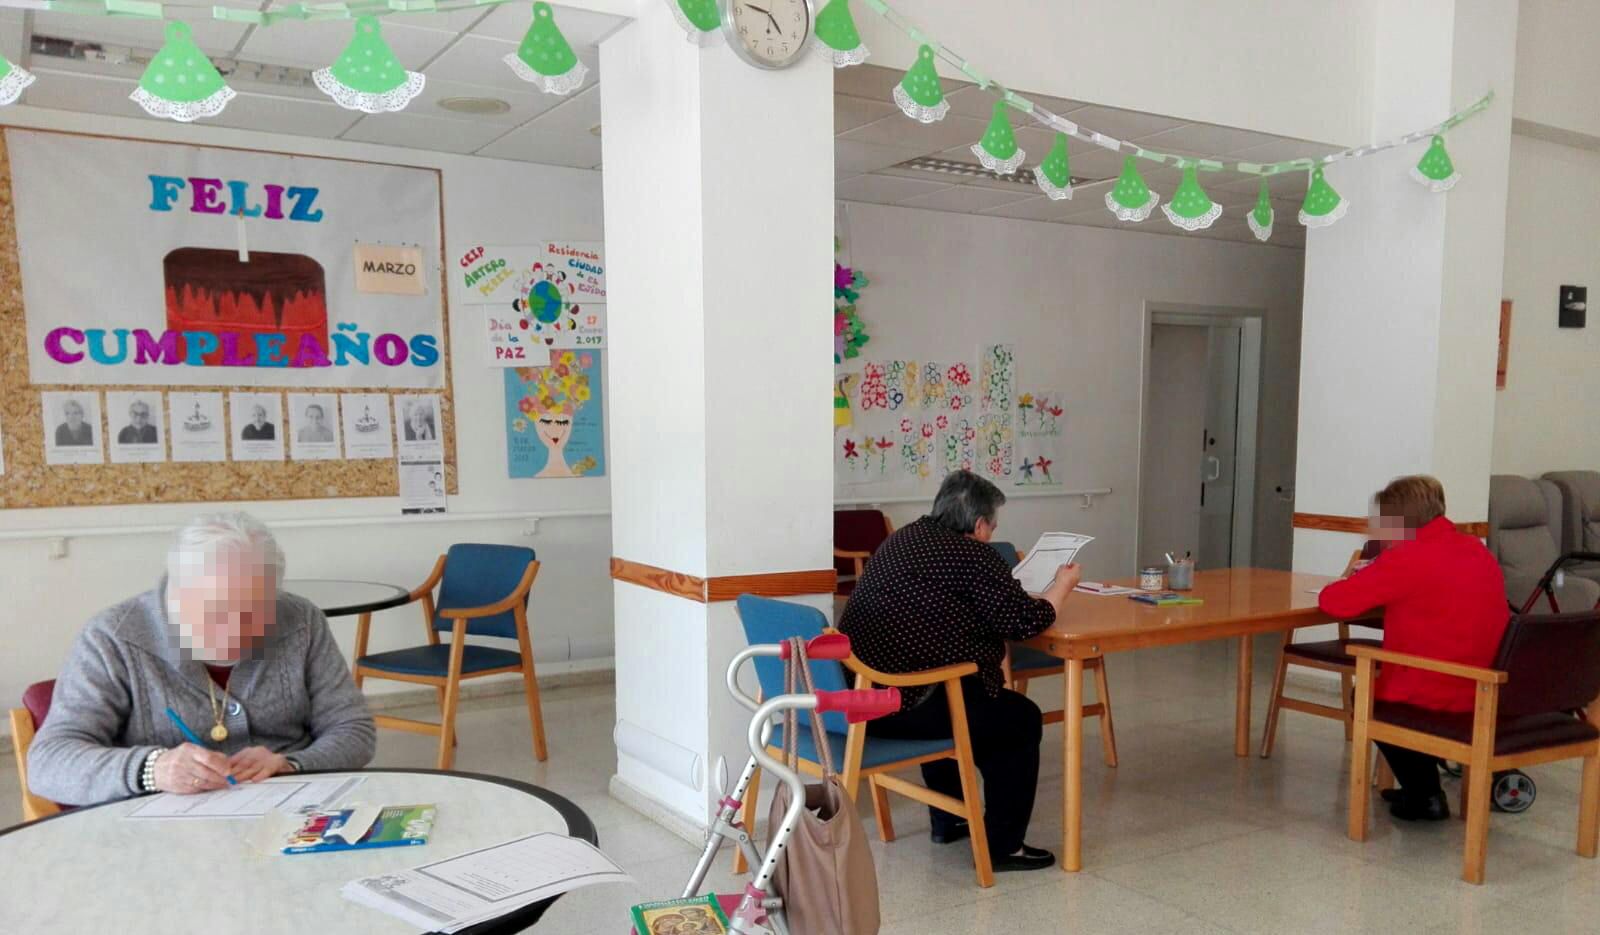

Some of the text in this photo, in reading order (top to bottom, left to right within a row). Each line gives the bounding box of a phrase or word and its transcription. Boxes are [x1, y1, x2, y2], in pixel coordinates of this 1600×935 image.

[148, 174, 324, 222] FELIZ
[459, 246, 485, 267] CEIP
[548, 244, 600, 260] Residencia
[362, 261, 416, 276] MARZO
[464, 258, 507, 288] ARTERO
[44, 322, 440, 368] CUMPLEAÑOS
[495, 346, 526, 359] PAZ
